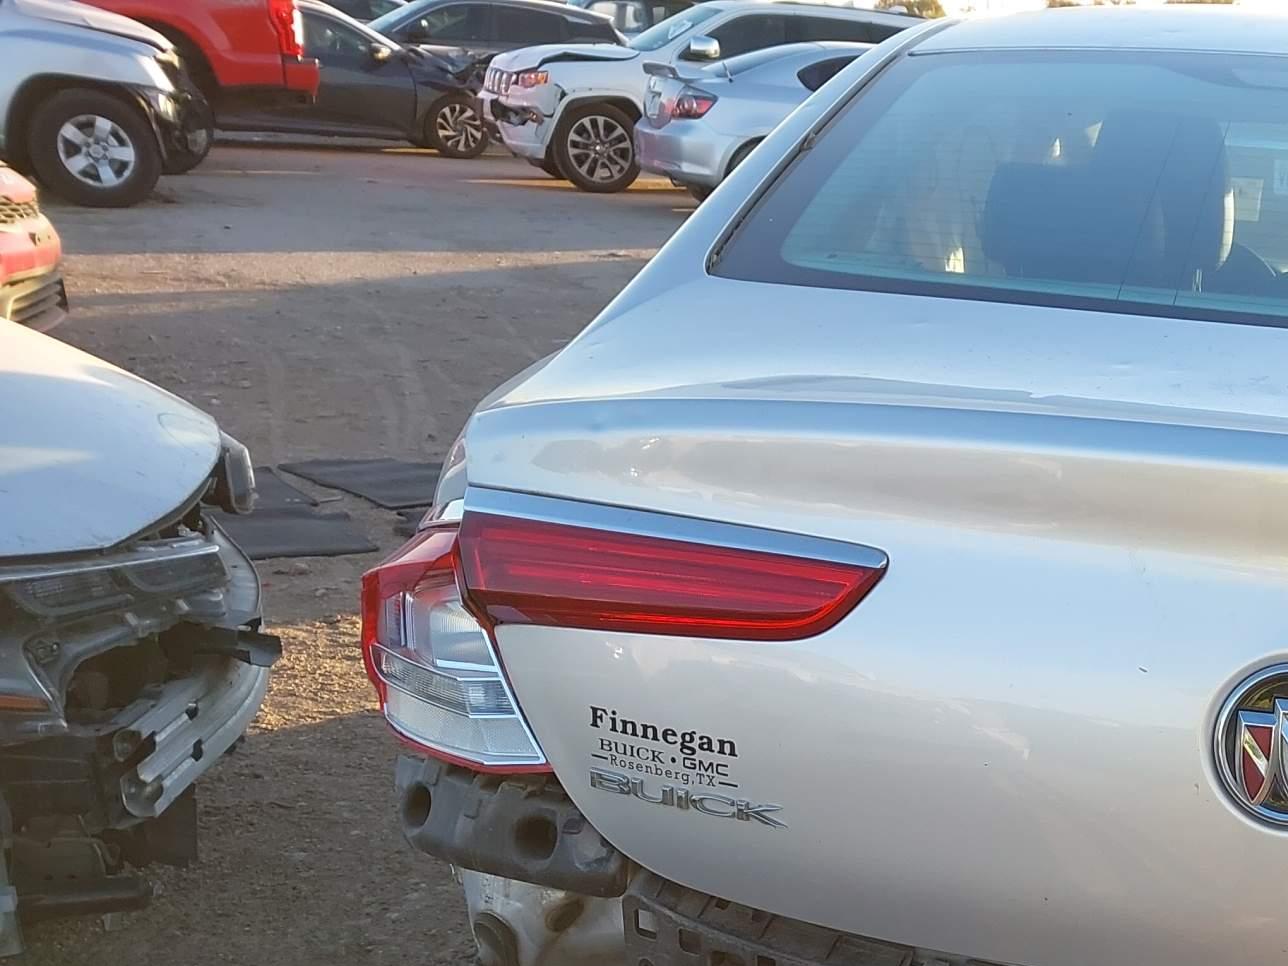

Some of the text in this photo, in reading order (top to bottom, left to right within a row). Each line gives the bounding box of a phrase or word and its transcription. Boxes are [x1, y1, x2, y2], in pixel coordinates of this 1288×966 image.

[590, 705, 738, 757] Finnegan
[598, 737, 729, 777] BUICK GMC
[589, 766, 789, 830] BUICK
